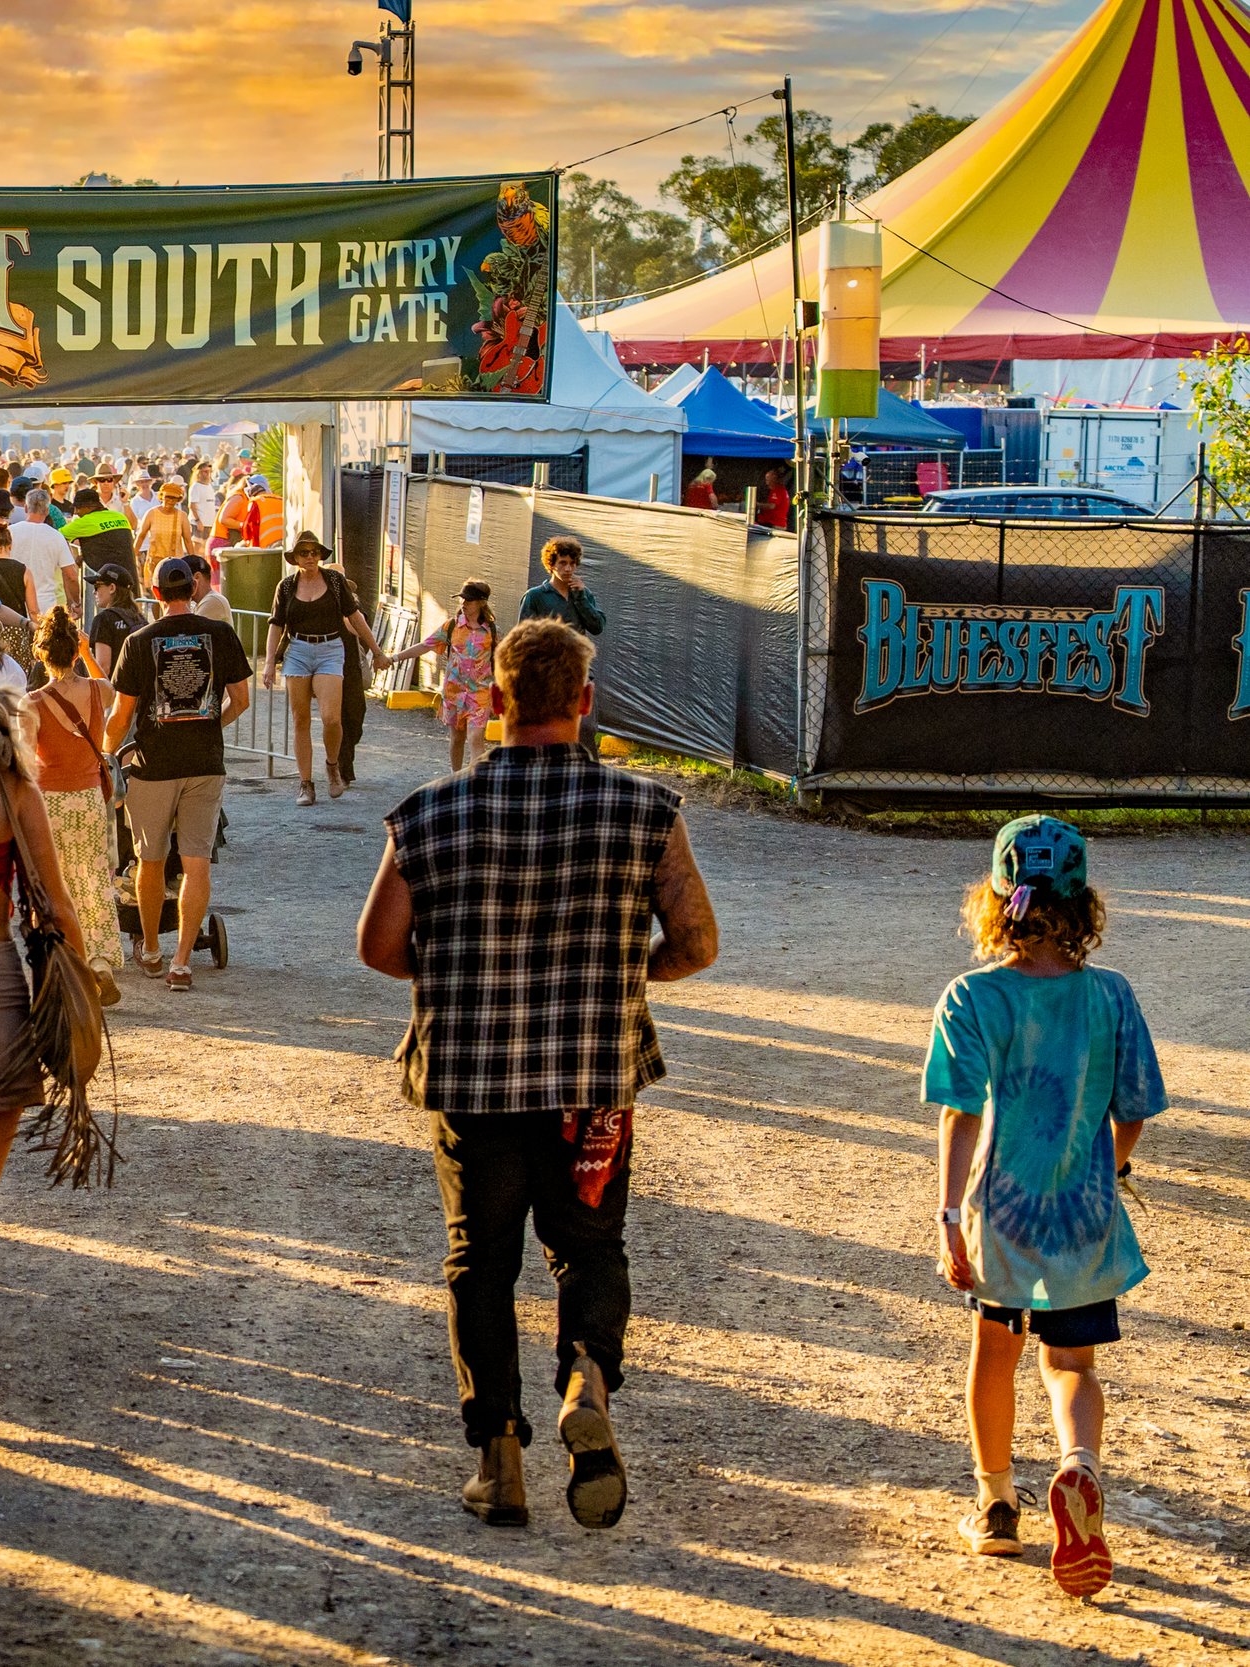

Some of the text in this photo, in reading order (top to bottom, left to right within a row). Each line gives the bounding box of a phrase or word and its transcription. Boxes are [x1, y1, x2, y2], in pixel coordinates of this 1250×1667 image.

[337, 236, 462, 290] ENTRY
[56, 242, 324, 351] SOUTH
[349, 292, 450, 343] GATE
[921, 606, 1093, 622] BYRON BAY
[854, 578, 1164, 716] BLUESFEST
